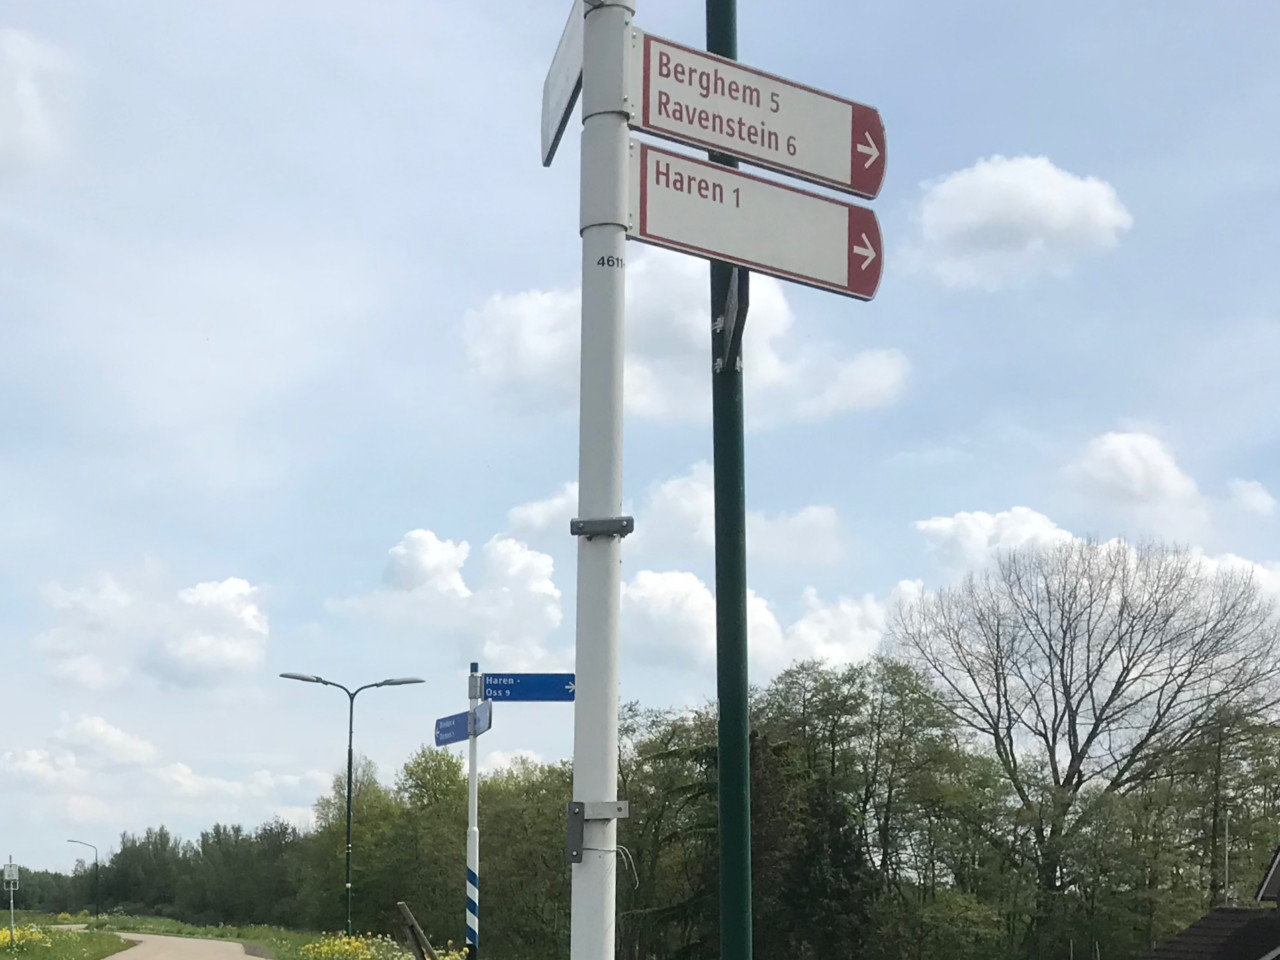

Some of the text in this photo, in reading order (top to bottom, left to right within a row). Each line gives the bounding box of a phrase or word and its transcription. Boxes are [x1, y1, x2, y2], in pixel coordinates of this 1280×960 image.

[658, 51, 780, 113] Berghem 5
[658, 90, 797, 156] Ravenstein 6
[655, 160, 740, 208] Haren 1
[485, 688, 502, 697] Oss
[486, 676, 514, 685] Haren
